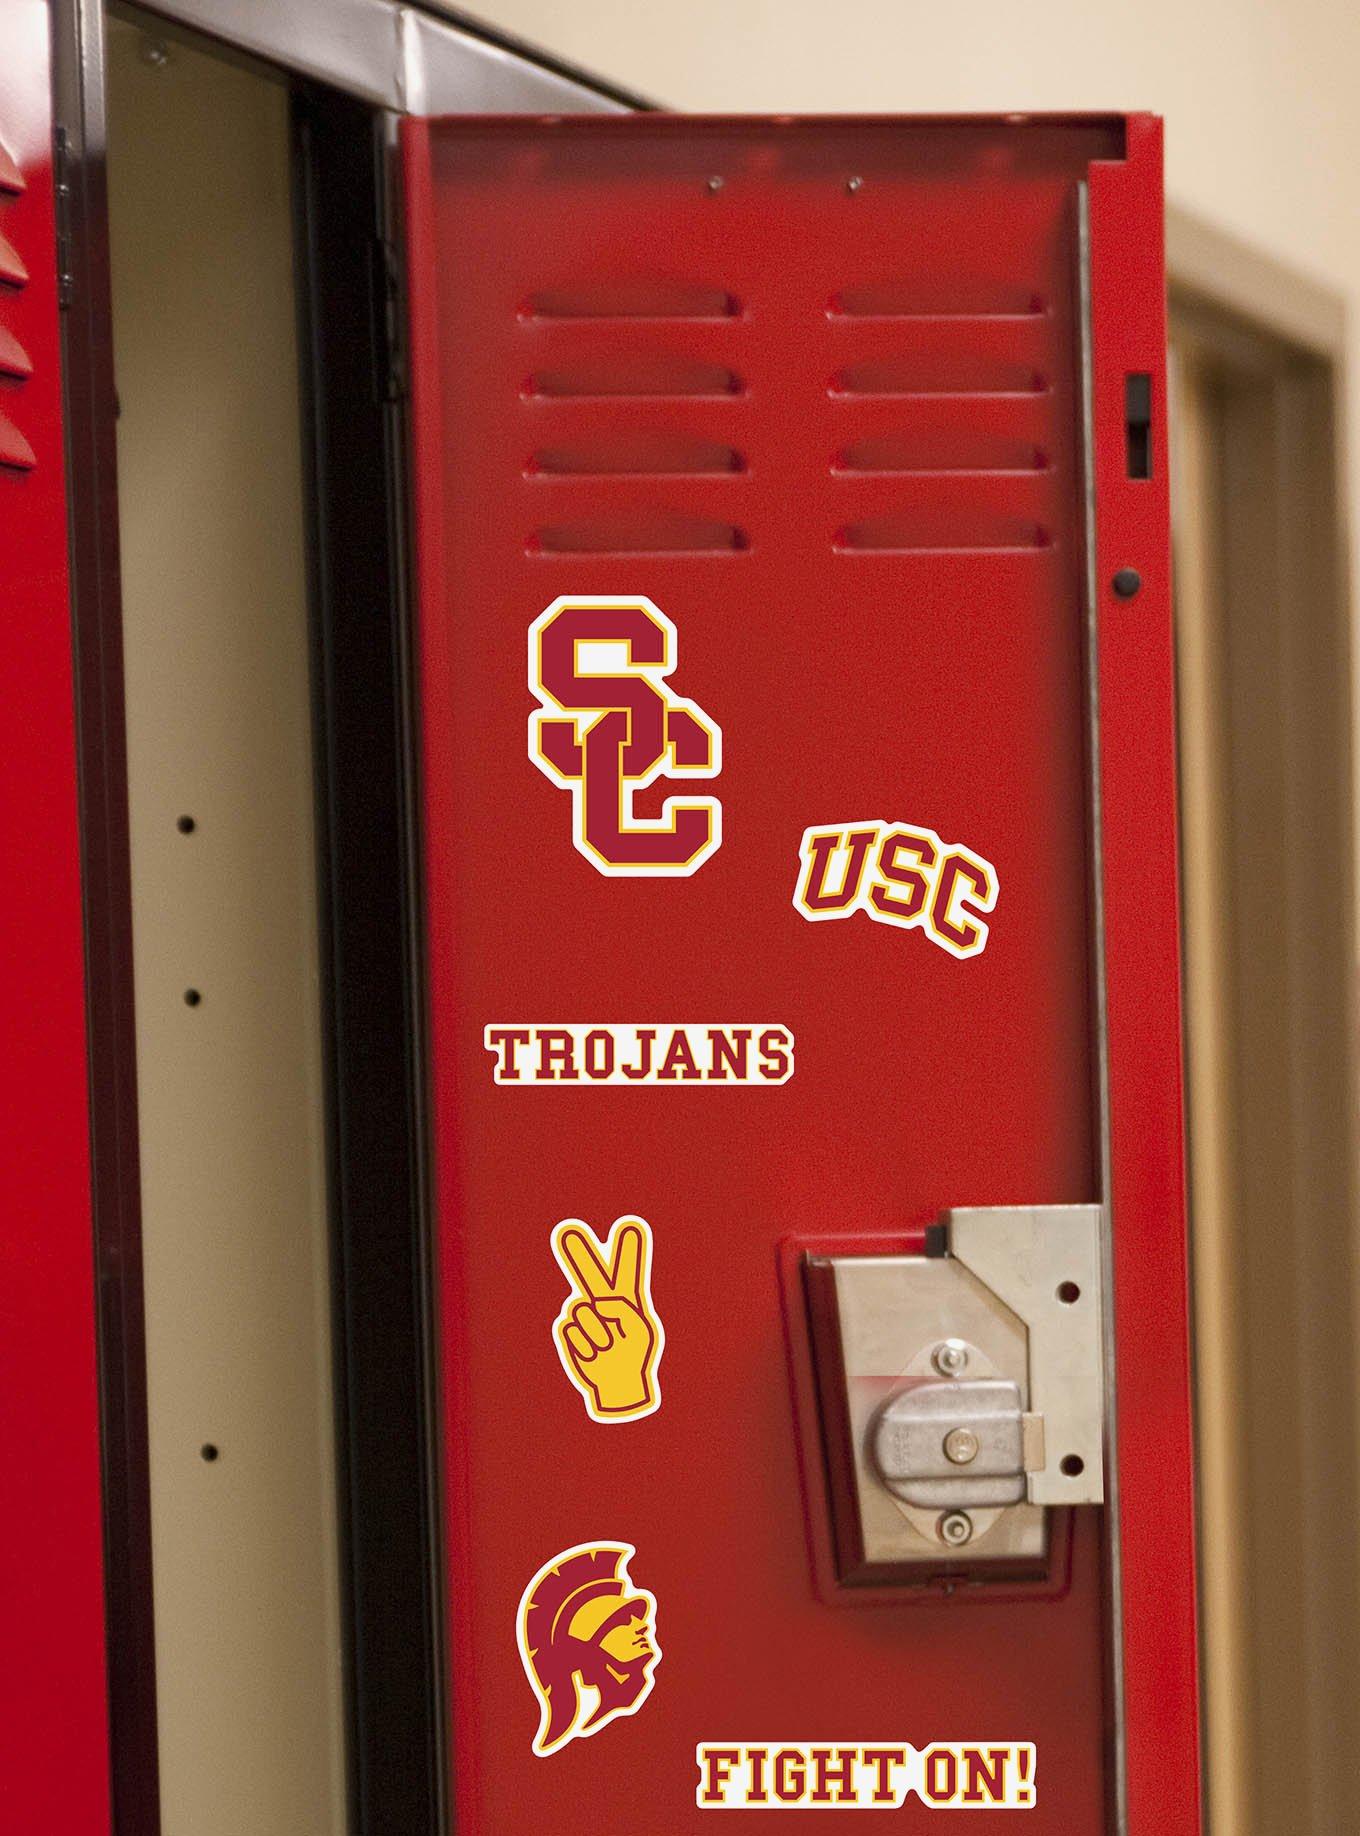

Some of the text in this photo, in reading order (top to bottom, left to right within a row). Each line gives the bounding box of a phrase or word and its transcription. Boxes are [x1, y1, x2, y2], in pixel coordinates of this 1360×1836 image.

[537, 605, 712, 867] SC
[801, 827, 989, 951] USC
[489, 1029, 789, 1080] TROJANS
[702, 1748, 1034, 1803] FIGHT ON!
